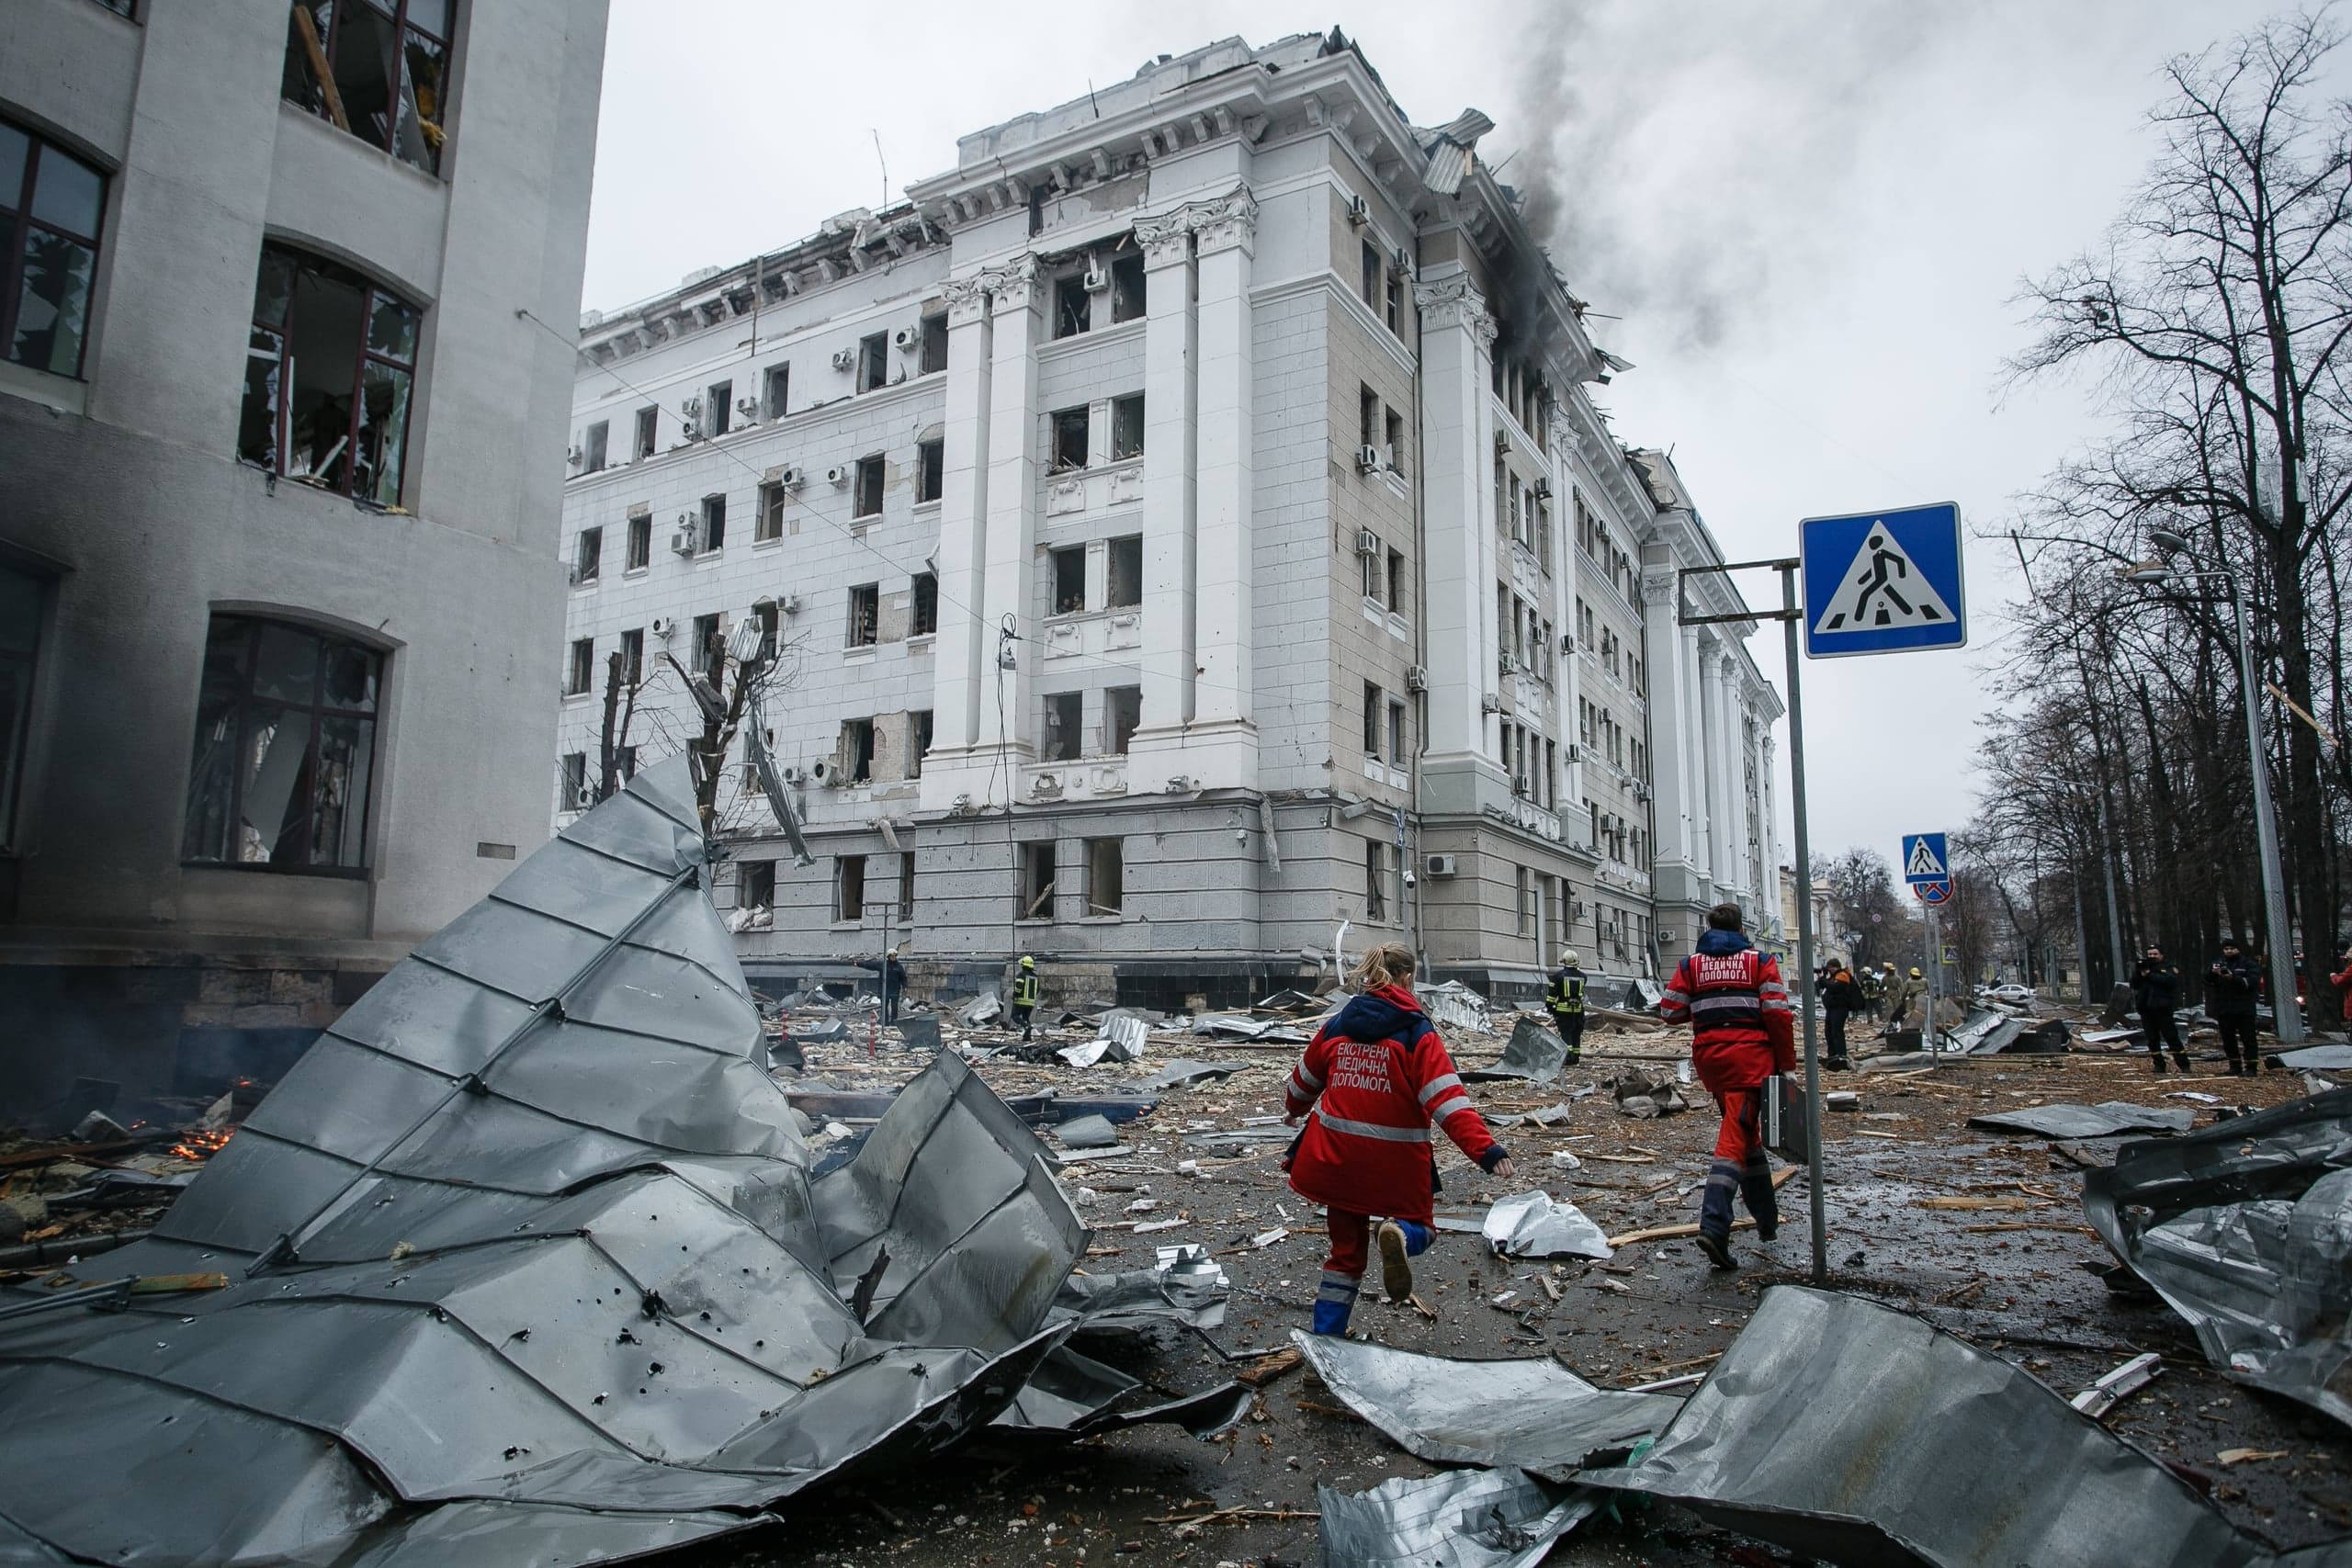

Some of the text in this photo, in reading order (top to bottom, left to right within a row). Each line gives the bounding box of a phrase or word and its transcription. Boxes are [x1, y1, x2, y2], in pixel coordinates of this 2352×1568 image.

[1702, 960, 1744, 971] МЕДИЧНА
[1700, 970, 1747, 983] ДОПОМОГА
[1337, 1043, 1389, 1060] ЕКСТРЕНА
[1337, 1057, 1387, 1075] МЕДИЧНА
[1331, 1072, 1391, 1093] ДОПОМОГА
